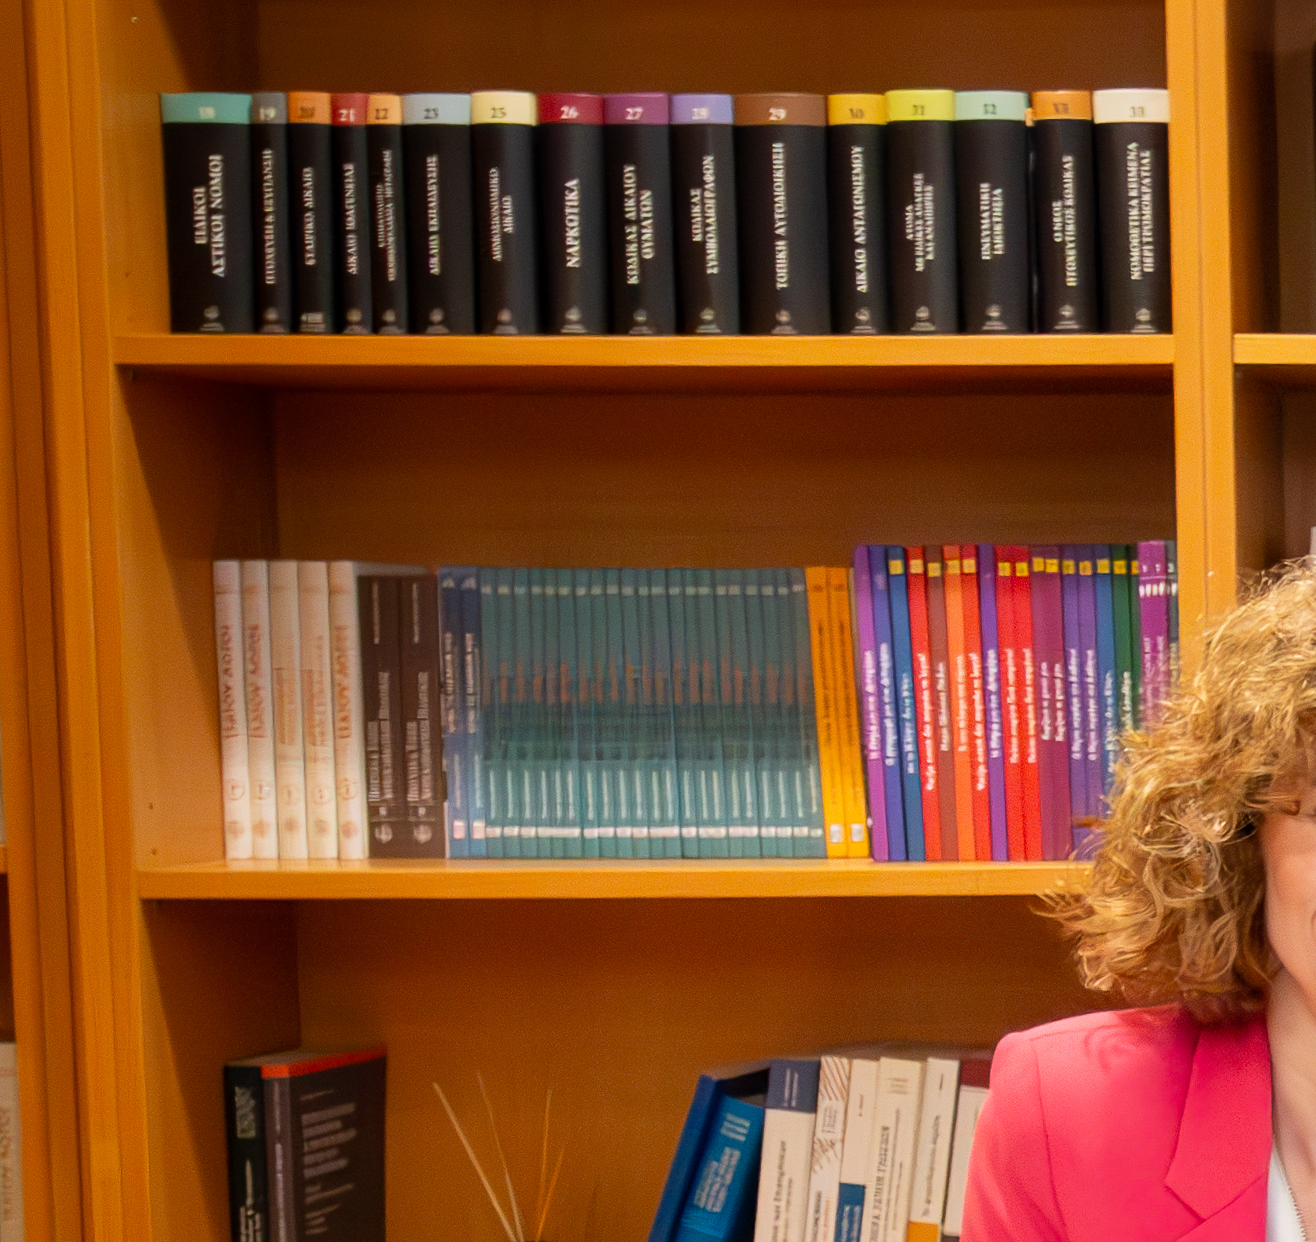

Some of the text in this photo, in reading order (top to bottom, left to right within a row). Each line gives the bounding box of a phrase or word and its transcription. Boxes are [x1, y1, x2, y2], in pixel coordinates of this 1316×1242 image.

[339, 108, 355, 122] 21
[559, 106, 580, 120] 26
[625, 107, 644, 121] 27
[768, 108, 788, 122] 29
[192, 186, 208, 244] ΕΙΔΙΚΟΙ
[208, 154, 225, 277] ΑΣΤΙΚΟΙ ΝΟΜΟΙ
[302, 166, 314, 208] ΔΙΚΑΙΟ
[426, 153, 441, 275] ΔΙΚΑΙΟ ΕΚΠΑΙΔΕΥΣΗΣ
[502, 194, 514, 234] ΔΙΚΑΙΟ
[689, 187, 703, 242] ΚΩΔΙΚΑΣ
[702, 155, 719, 274] ΣΥΜΒΟΛΑΙΟΓΡΑΦΩΝ
[771, 142, 789, 290] ΤΟΠΙΚΗ ΑΥΤΟΔΙΟΙΚΗΣΗ
[851, 145, 868, 293] ΔΙΚΑΙΟ ΑΝΤΑΓΩΝΙΣΜΟΥ
[979, 182, 993, 260] ΠΝΕΥΜΑΤΙΚΗ
[992, 187, 1005, 255] ΙΔΙΟΚΤΗΣΙΑ
[1052, 200, 1064, 232] ΝΕΟΣ
[1062, 154, 1078, 286] ΠΤΩΧΕΥΤΙΚΟΣ ΚΩΔΙΚΑΣ
[1127, 141, 1143, 280] ΝΟΜΟΘΕΤΙΚΑ ΚΕΙΜΕΝΑ
[1140, 150, 1155, 272] ΠΕΡΙ ΤΡΟΜΟΚΡΑΤΙΑΣ
[346, 233, 358, 274] ΔΙΚΑΙΟ
[564, 178, 581, 268] ΝΑΡΚΩΤΙΚΑ
[623, 164, 640, 285] ΚΩΔΙΚΑΣ ΔΙΚΑΙΟΥ
[639, 189, 655, 259] ΘΥΜΑΤΩΝ
